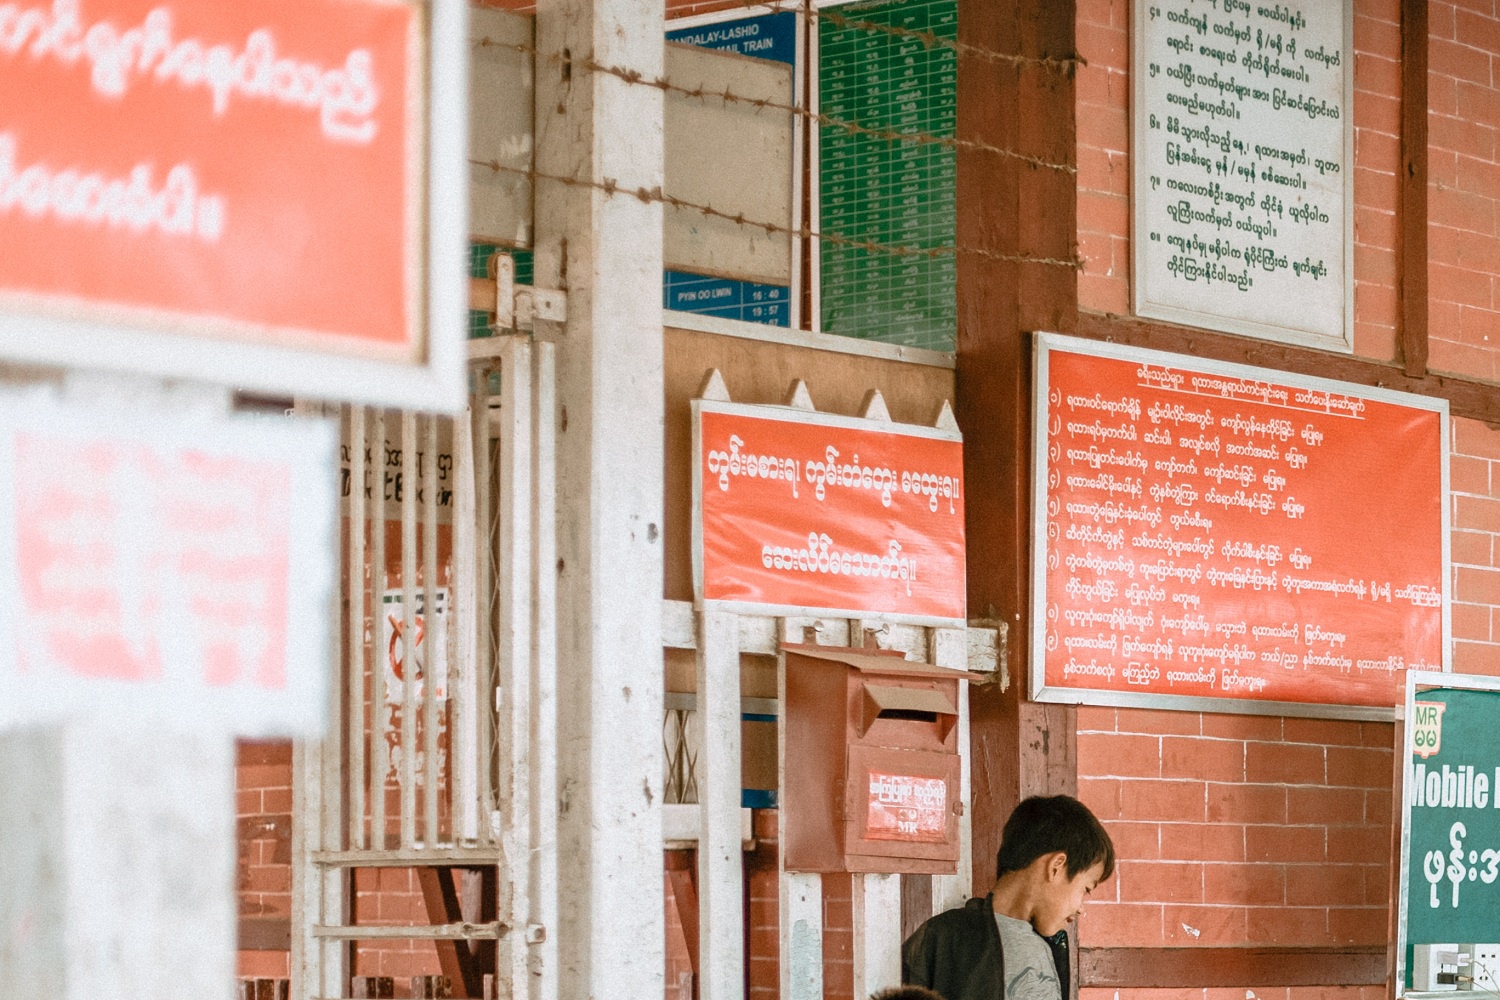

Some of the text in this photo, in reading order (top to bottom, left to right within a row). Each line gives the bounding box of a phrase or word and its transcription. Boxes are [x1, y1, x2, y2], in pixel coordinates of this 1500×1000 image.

[669, 23, 760, 45] NDALAY-LASHIO
[742, 38, 774, 53] TRAIN
[1213, 21, 1251, 45] လက်မှတ်
[1305, 46, 1341, 69] လက်မှတ်
[677, 291, 697, 303] PYIN
[1415, 706, 1438, 726] MR
[1411, 763, 1489, 809] Mobile
